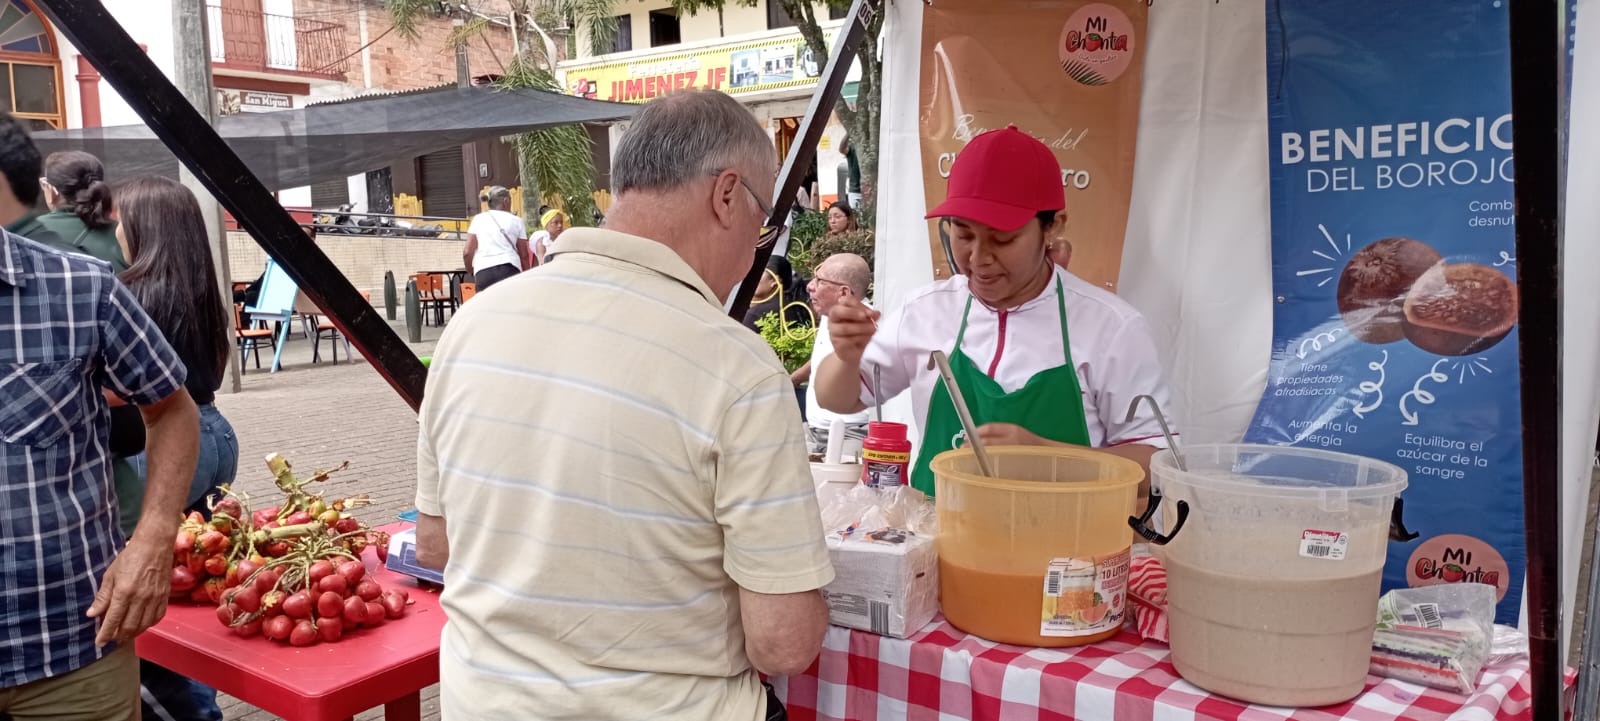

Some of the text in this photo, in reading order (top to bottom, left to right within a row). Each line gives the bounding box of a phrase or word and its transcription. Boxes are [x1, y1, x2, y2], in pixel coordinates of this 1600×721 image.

[1086, 16, 1107, 32] MI
[608, 67, 727, 102] JIMENEZ JF
[1307, 167, 1365, 193] DEL
[1468, 200, 1514, 212] Comb
[1300, 363, 1328, 373] Tiene
[1276, 374, 1344, 386] propiedades
[1288, 419, 1358, 434] Aumenta la
[1404, 433, 1484, 452] Equilibra el
[1396, 446, 1488, 468] azúcar de la
[1415, 464, 1465, 480] sangre
[1442, 547, 1472, 566] MI
